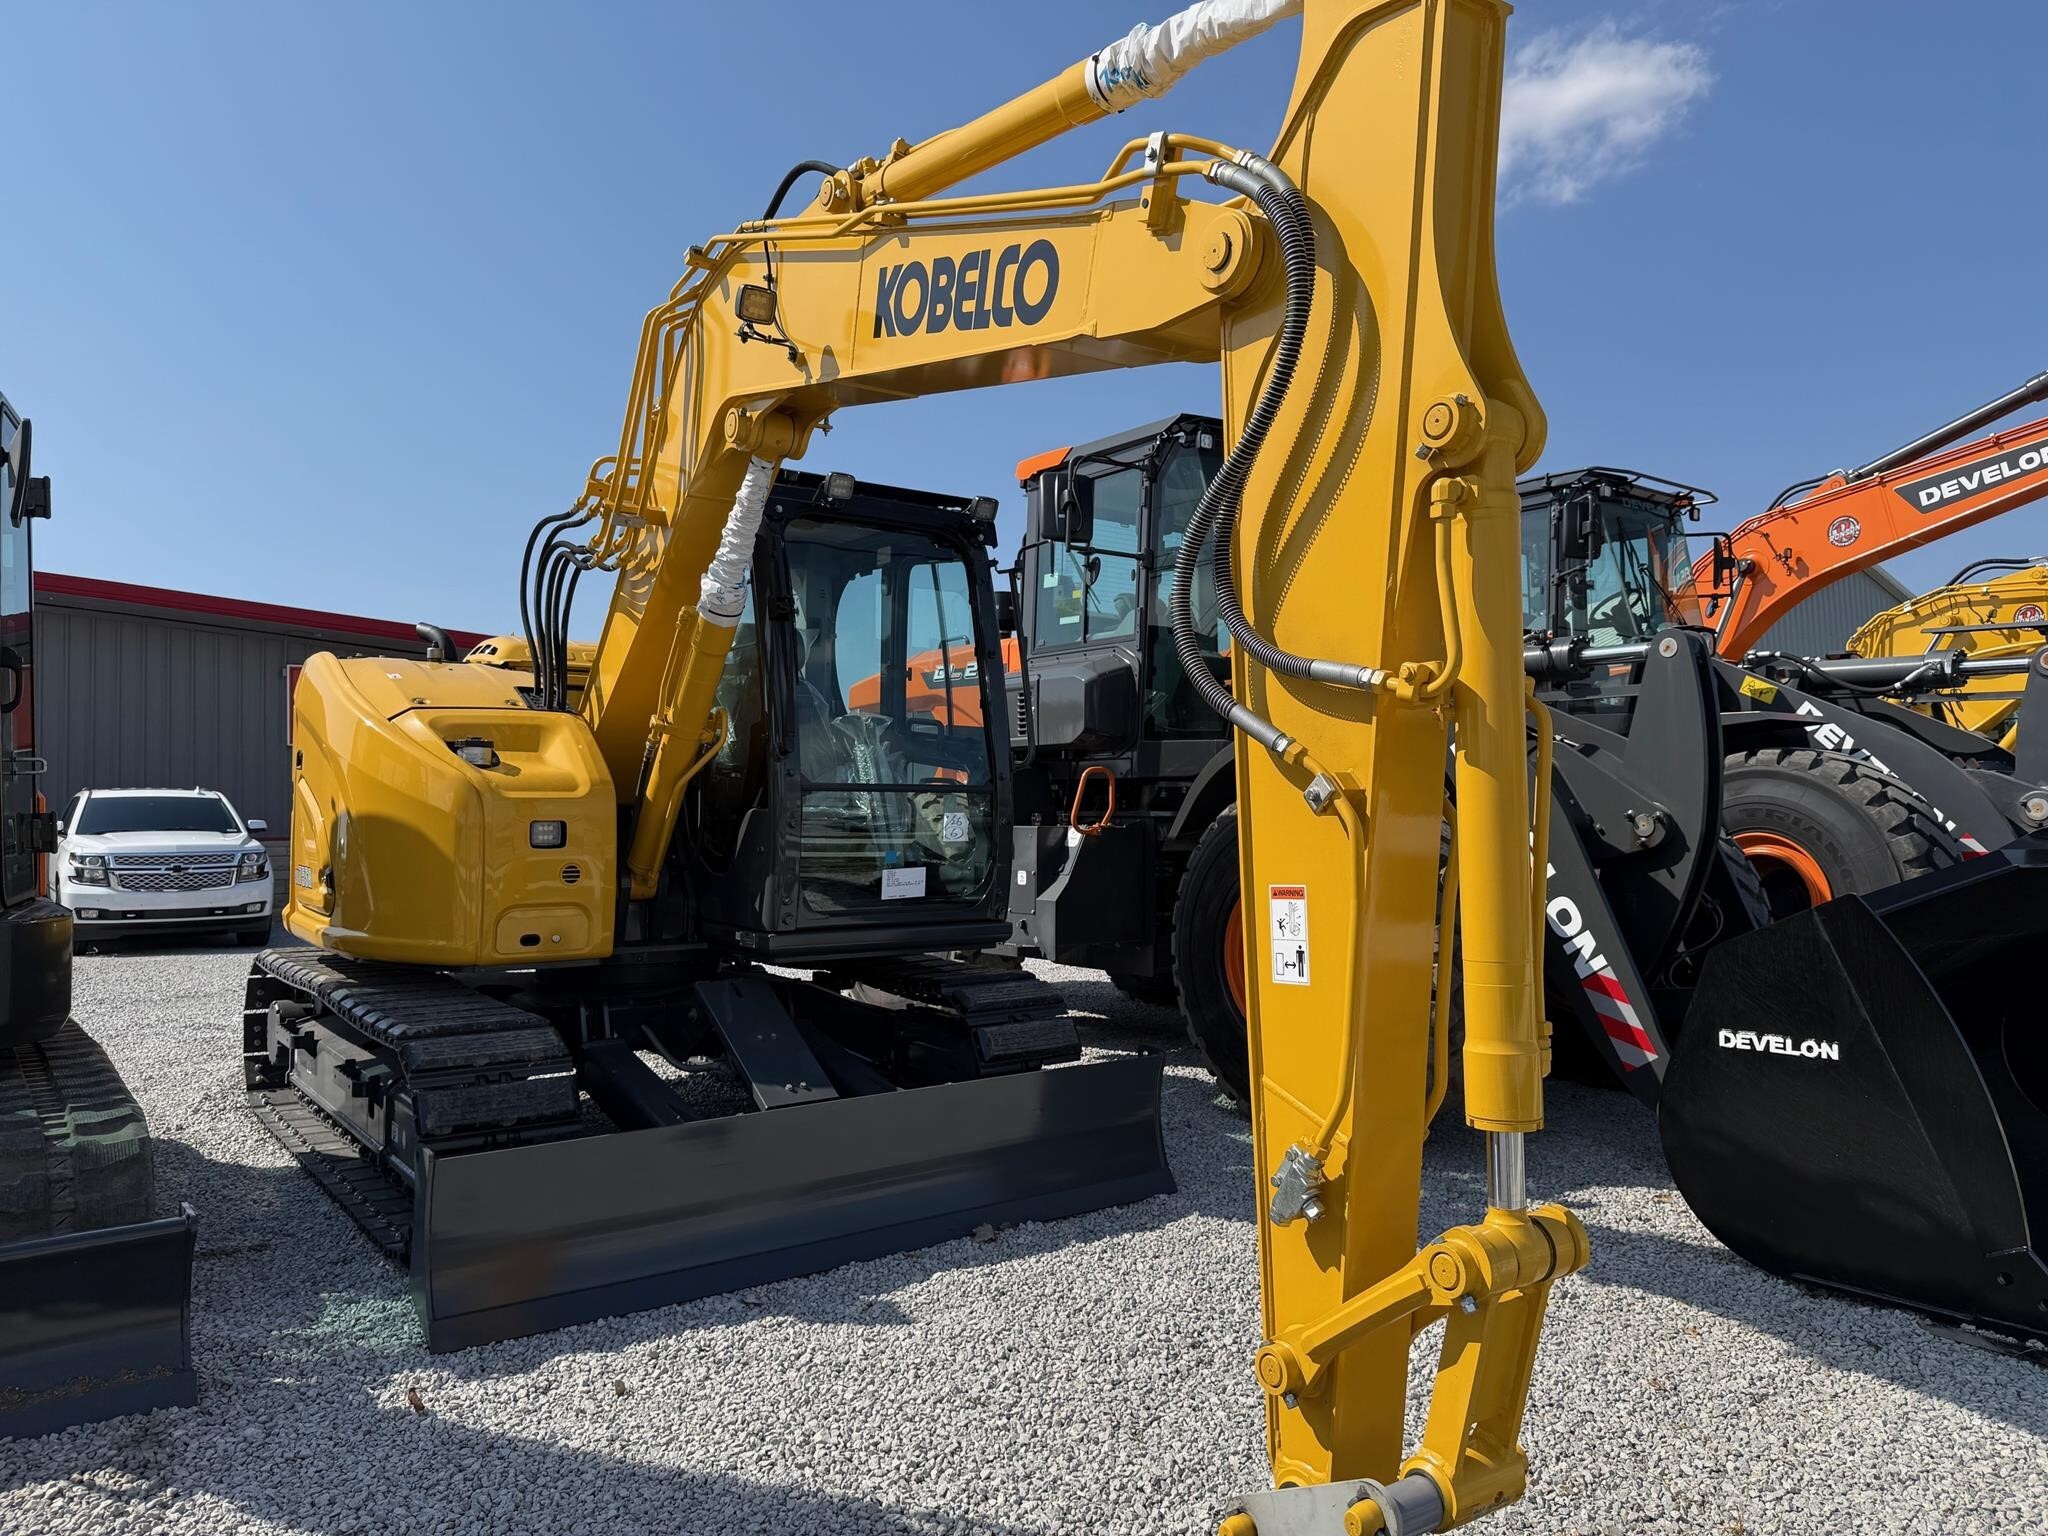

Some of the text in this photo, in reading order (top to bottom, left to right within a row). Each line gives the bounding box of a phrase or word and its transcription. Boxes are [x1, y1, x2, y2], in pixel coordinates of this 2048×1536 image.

[873, 239, 1060, 338] KOBELCO
[1277, 889, 1304, 897] WARNING
[1719, 1028, 1839, 1060] DEVELON
